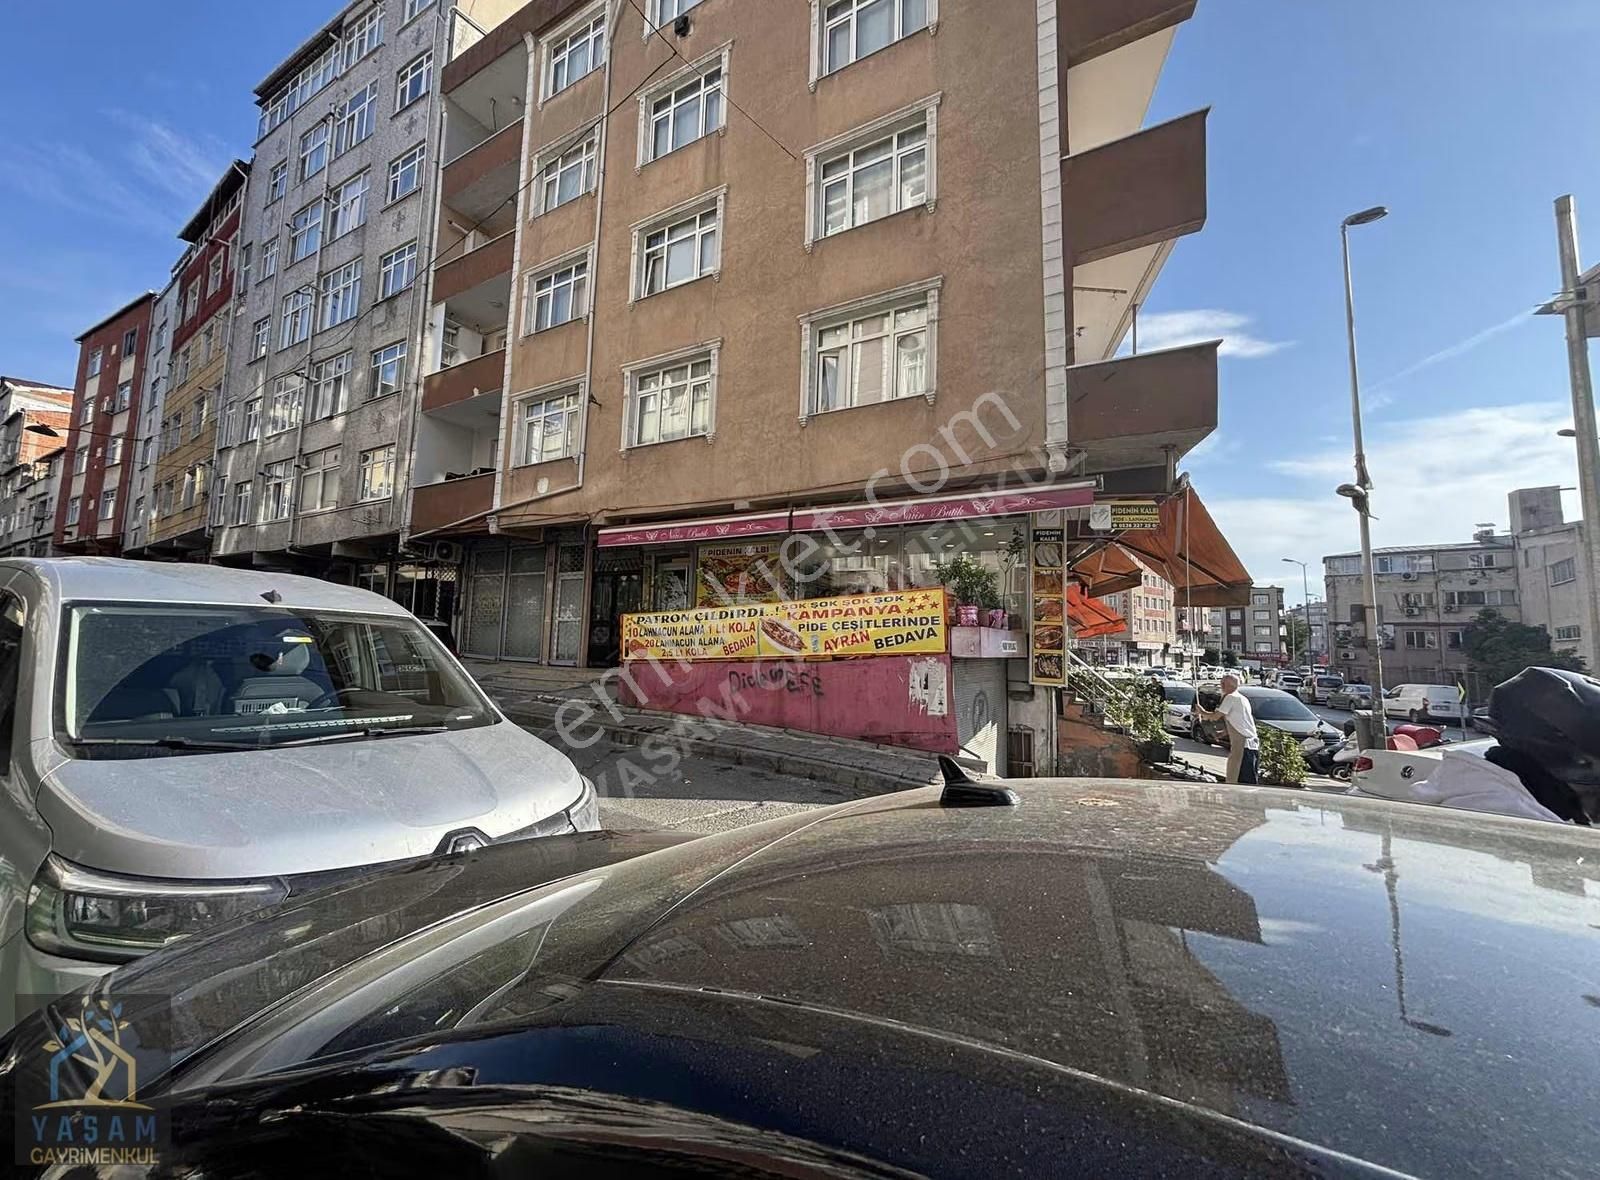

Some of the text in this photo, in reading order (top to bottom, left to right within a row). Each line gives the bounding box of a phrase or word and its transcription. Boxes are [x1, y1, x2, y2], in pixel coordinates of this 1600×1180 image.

[636, 613, 690, 625] PATRON
[787, 604, 901, 621] KAMPANYA
[679, 625, 704, 636] ALANA
[728, 621, 756, 633] KOLA
[798, 615, 941, 632] PİDE ÇEŞİTLERİNDE
[698, 638, 725, 647] ALANA
[722, 635, 757, 656] BEDAVA
[823, 627, 938, 652] AYRAN BEDAVA
